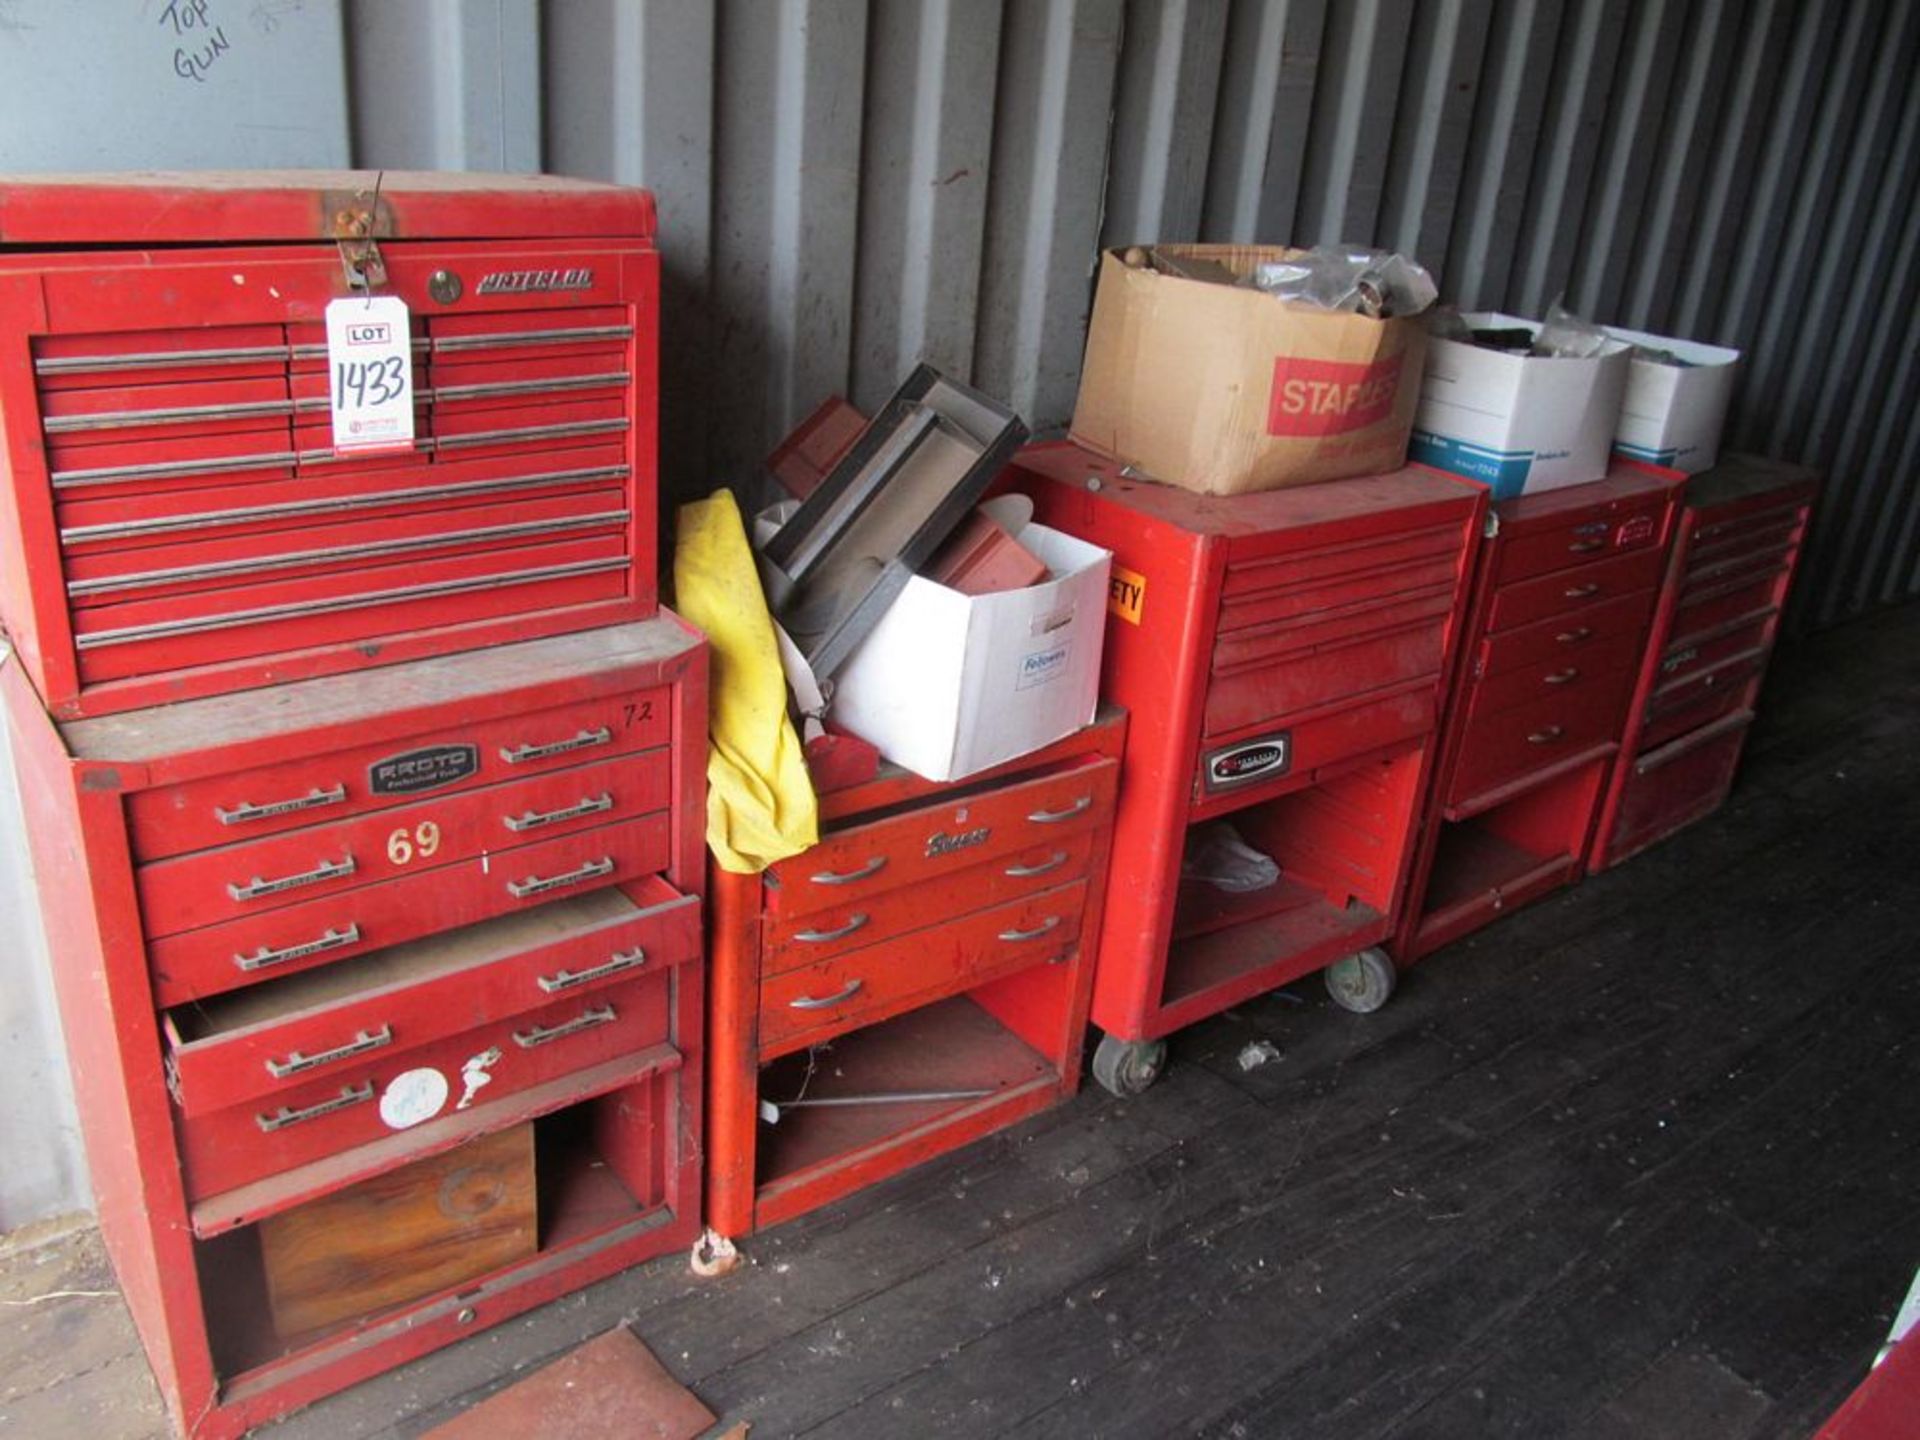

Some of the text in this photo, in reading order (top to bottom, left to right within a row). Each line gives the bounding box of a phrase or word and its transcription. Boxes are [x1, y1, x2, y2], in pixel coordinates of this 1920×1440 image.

[159, 0, 208, 35] TOP
[174, 26, 230, 82] GUN
[475, 269, 593, 295] WATERLOO
[351, 327, 385, 341] LOT
[337, 356, 405, 410] 1433
[623, 702, 652, 726] 72
[378, 750, 468, 780] PROTO
[387, 820, 441, 865] 69
